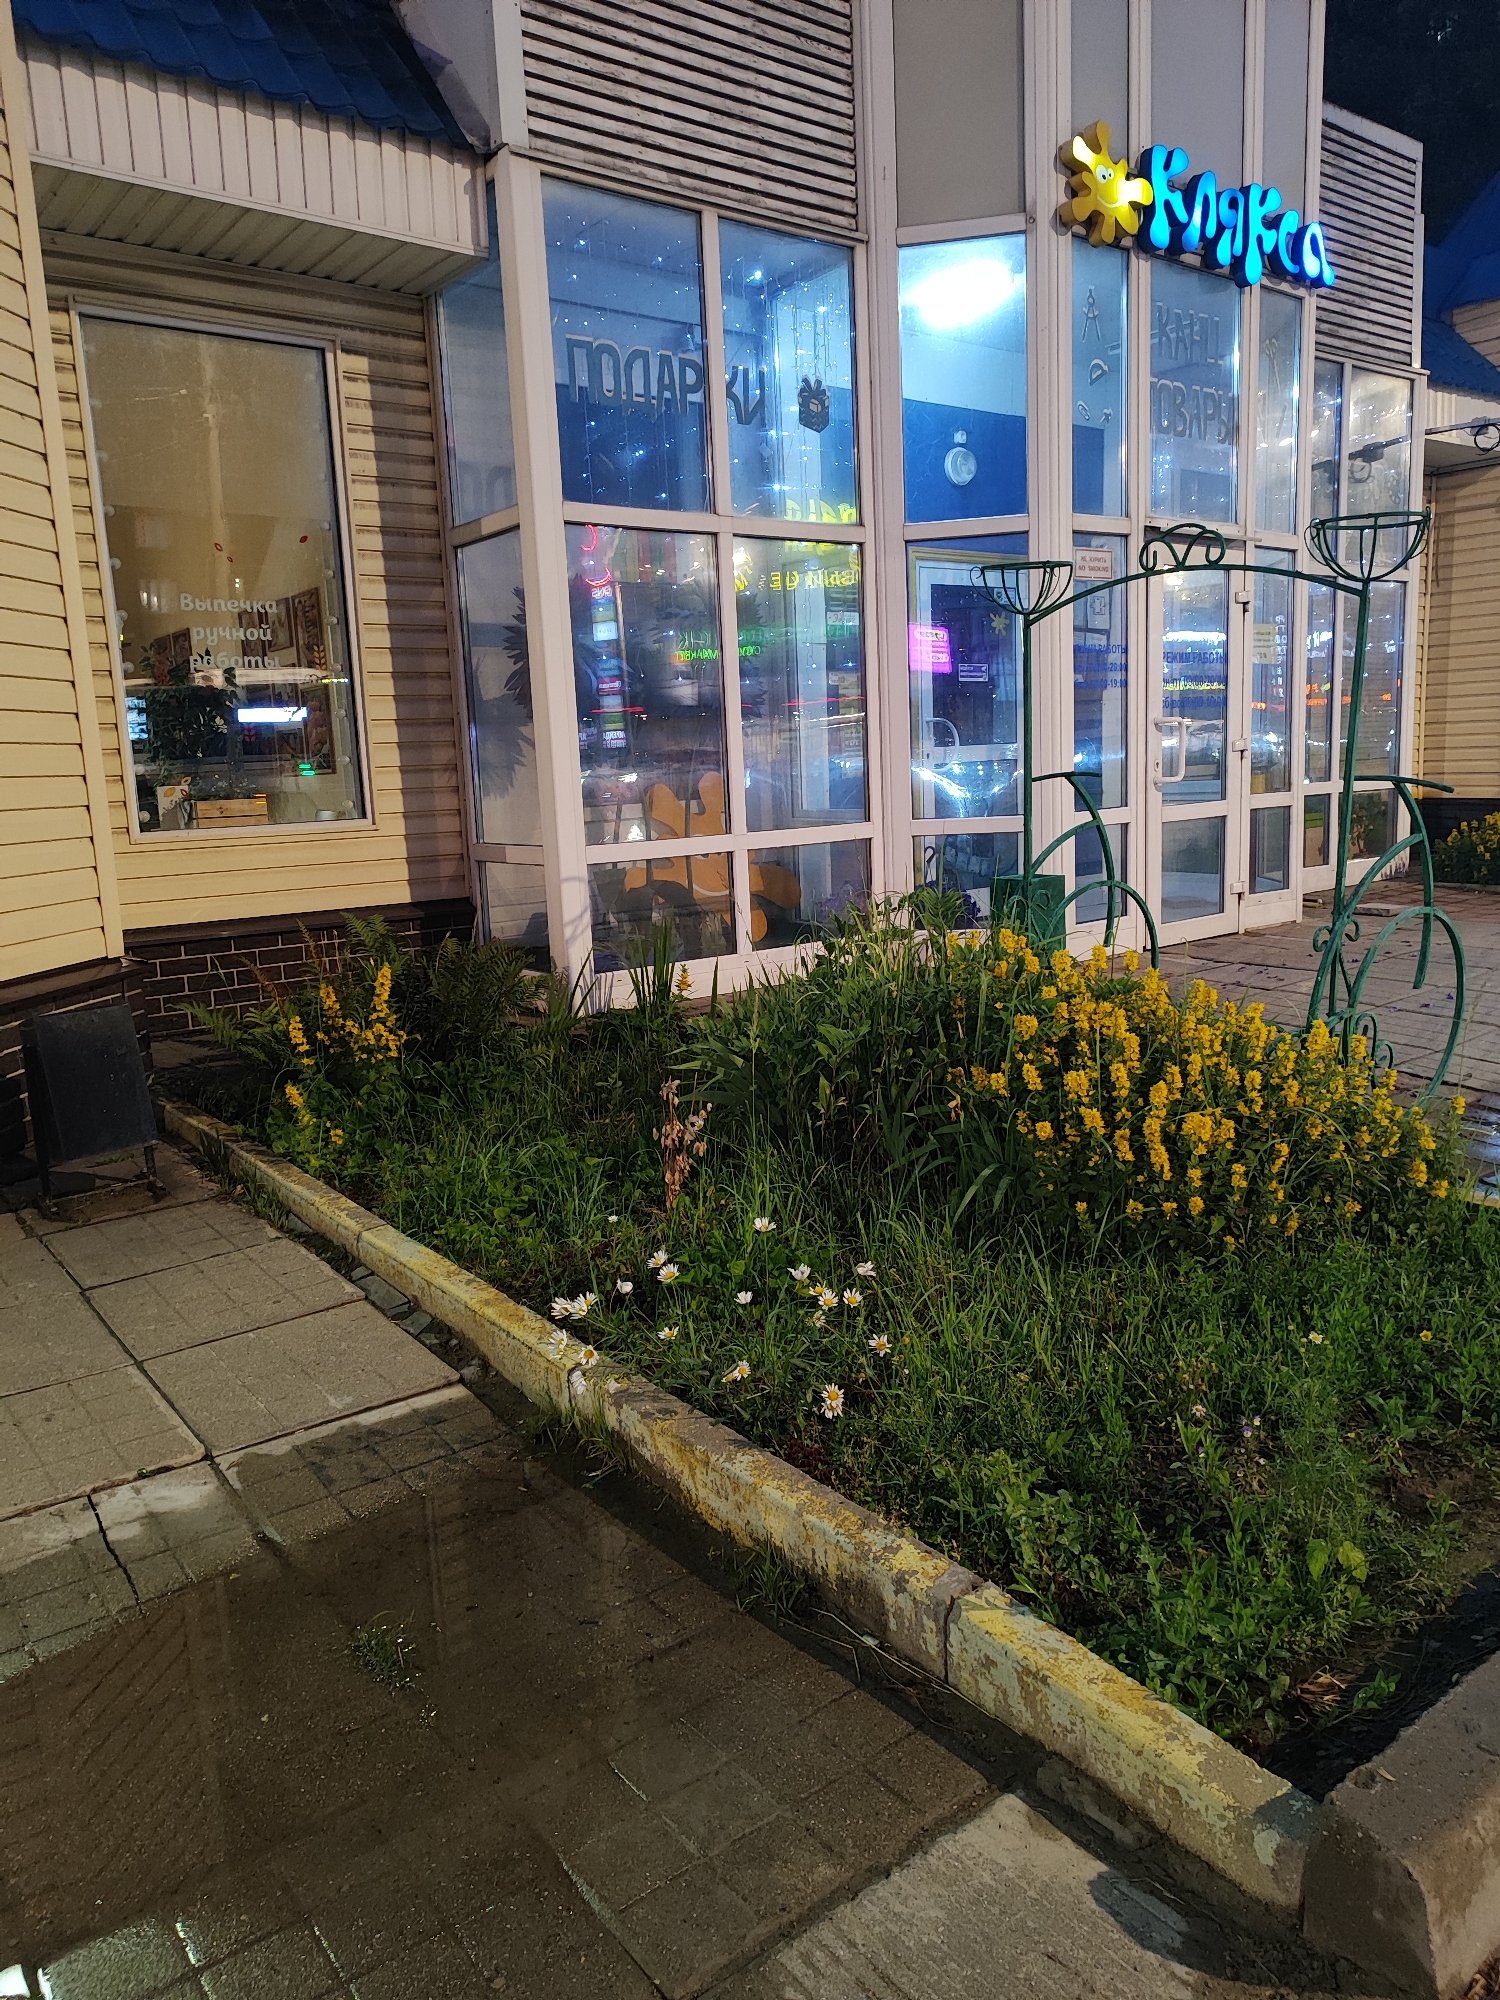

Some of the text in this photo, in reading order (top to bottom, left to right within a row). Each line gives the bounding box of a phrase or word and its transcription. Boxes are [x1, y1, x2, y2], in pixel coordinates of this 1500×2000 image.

[1155, 301, 1225, 370] КАНЦ
[1088, 565, 1109, 573] SMOKING
[179, 592, 278, 614] Выпечка
[191, 623, 272, 646] ручной
[189, 650, 282, 675] работы
